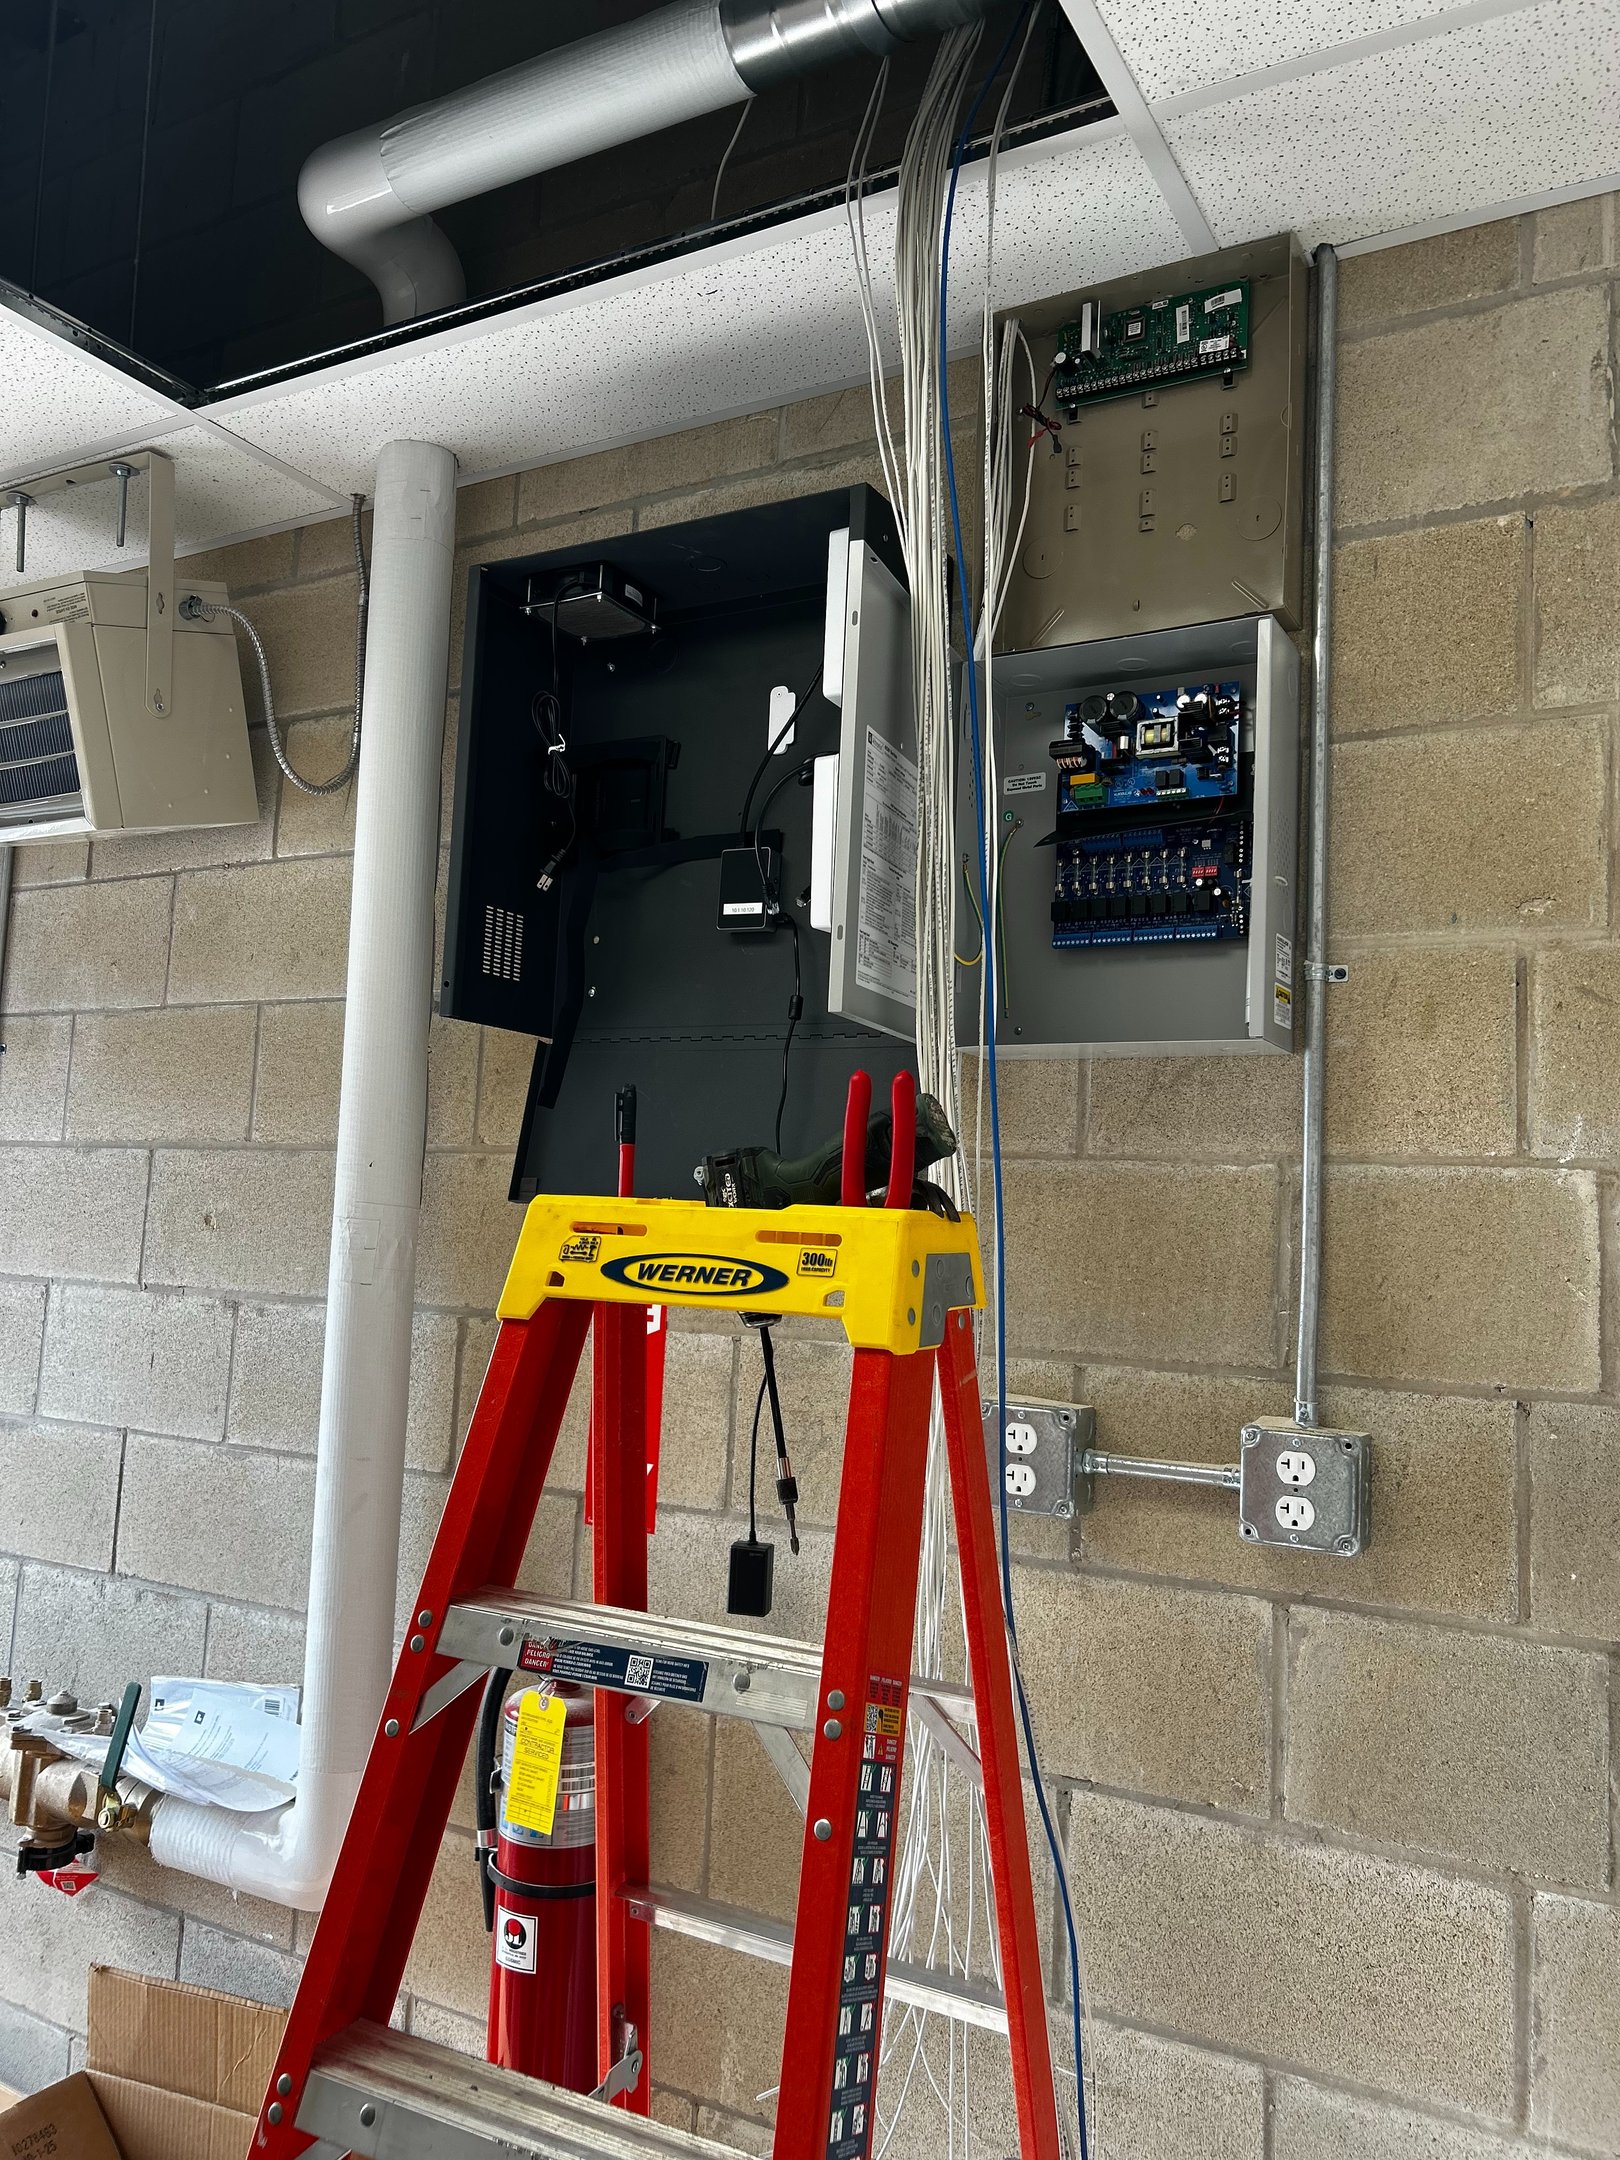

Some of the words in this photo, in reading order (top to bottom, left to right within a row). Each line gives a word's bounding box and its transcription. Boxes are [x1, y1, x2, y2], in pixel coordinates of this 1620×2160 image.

[636, 1262, 752, 1288] WERNER
[526, 1649, 551, 1659] PELIGRO
[520, 1738, 555, 1754] CONTRACTOR
[524, 1747, 550, 1760] SERVICED
